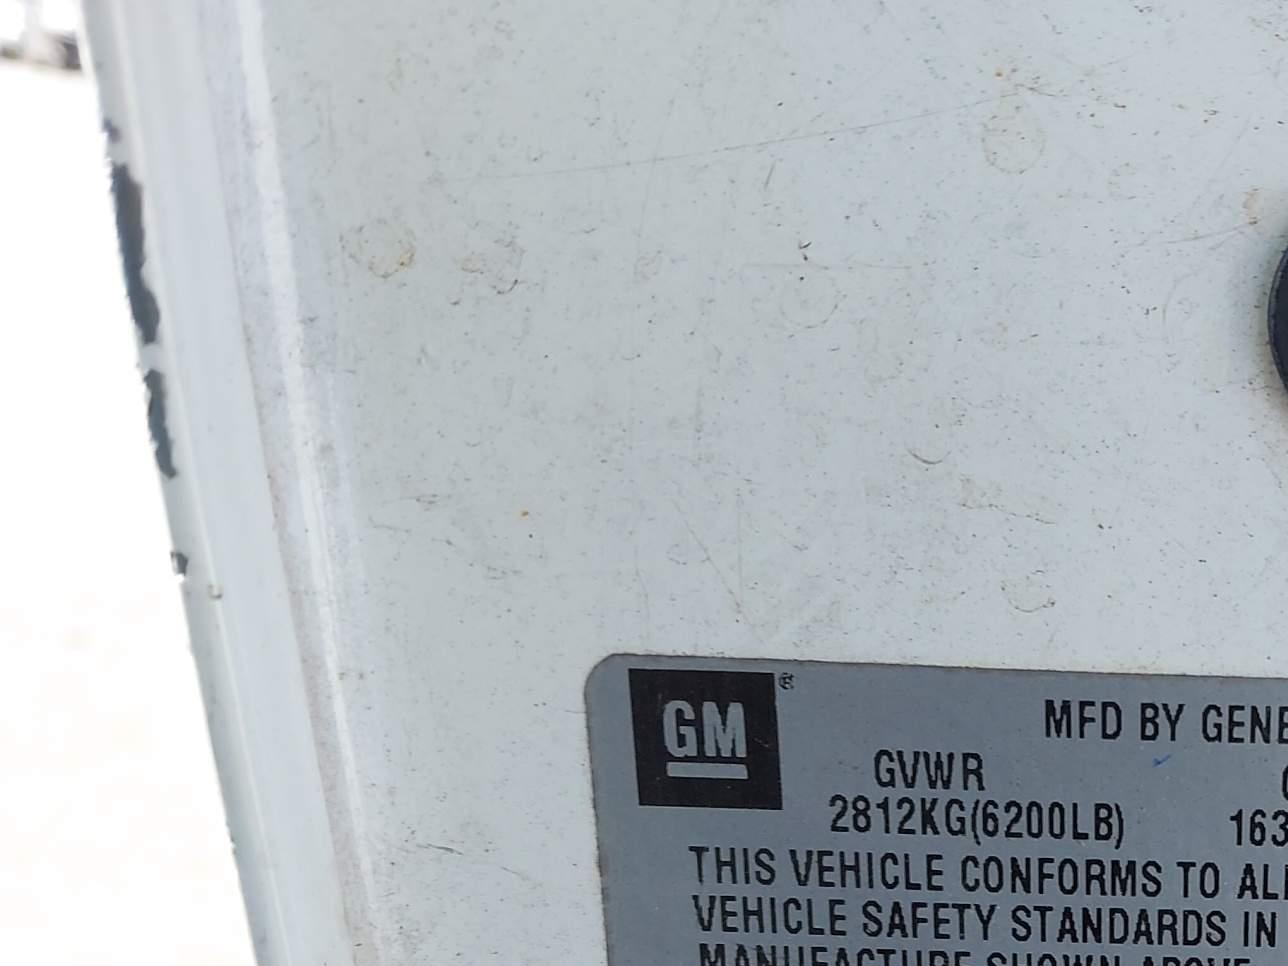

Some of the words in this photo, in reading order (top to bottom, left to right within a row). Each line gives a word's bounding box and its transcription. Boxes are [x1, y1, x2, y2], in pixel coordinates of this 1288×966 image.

[663, 700, 747, 758] GM
[1045, 699, 1122, 740] MFD
[1141, 703, 1185, 741] BY
[874, 750, 985, 791] GVWR
[829, 794, 1123, 849] 2812KG(6200LB)
[688, 846, 775, 885] THIS
[789, 849, 943, 891] VEHICLE
[961, 856, 1162, 897] CONFORMS
[1176, 862, 1219, 898] TO
[692, 895, 846, 936] VEHICLE
[862, 901, 997, 940] SAFETY
[1011, 905, 1226, 946] STANDARDS
[1244, 911, 1276, 947] IN
